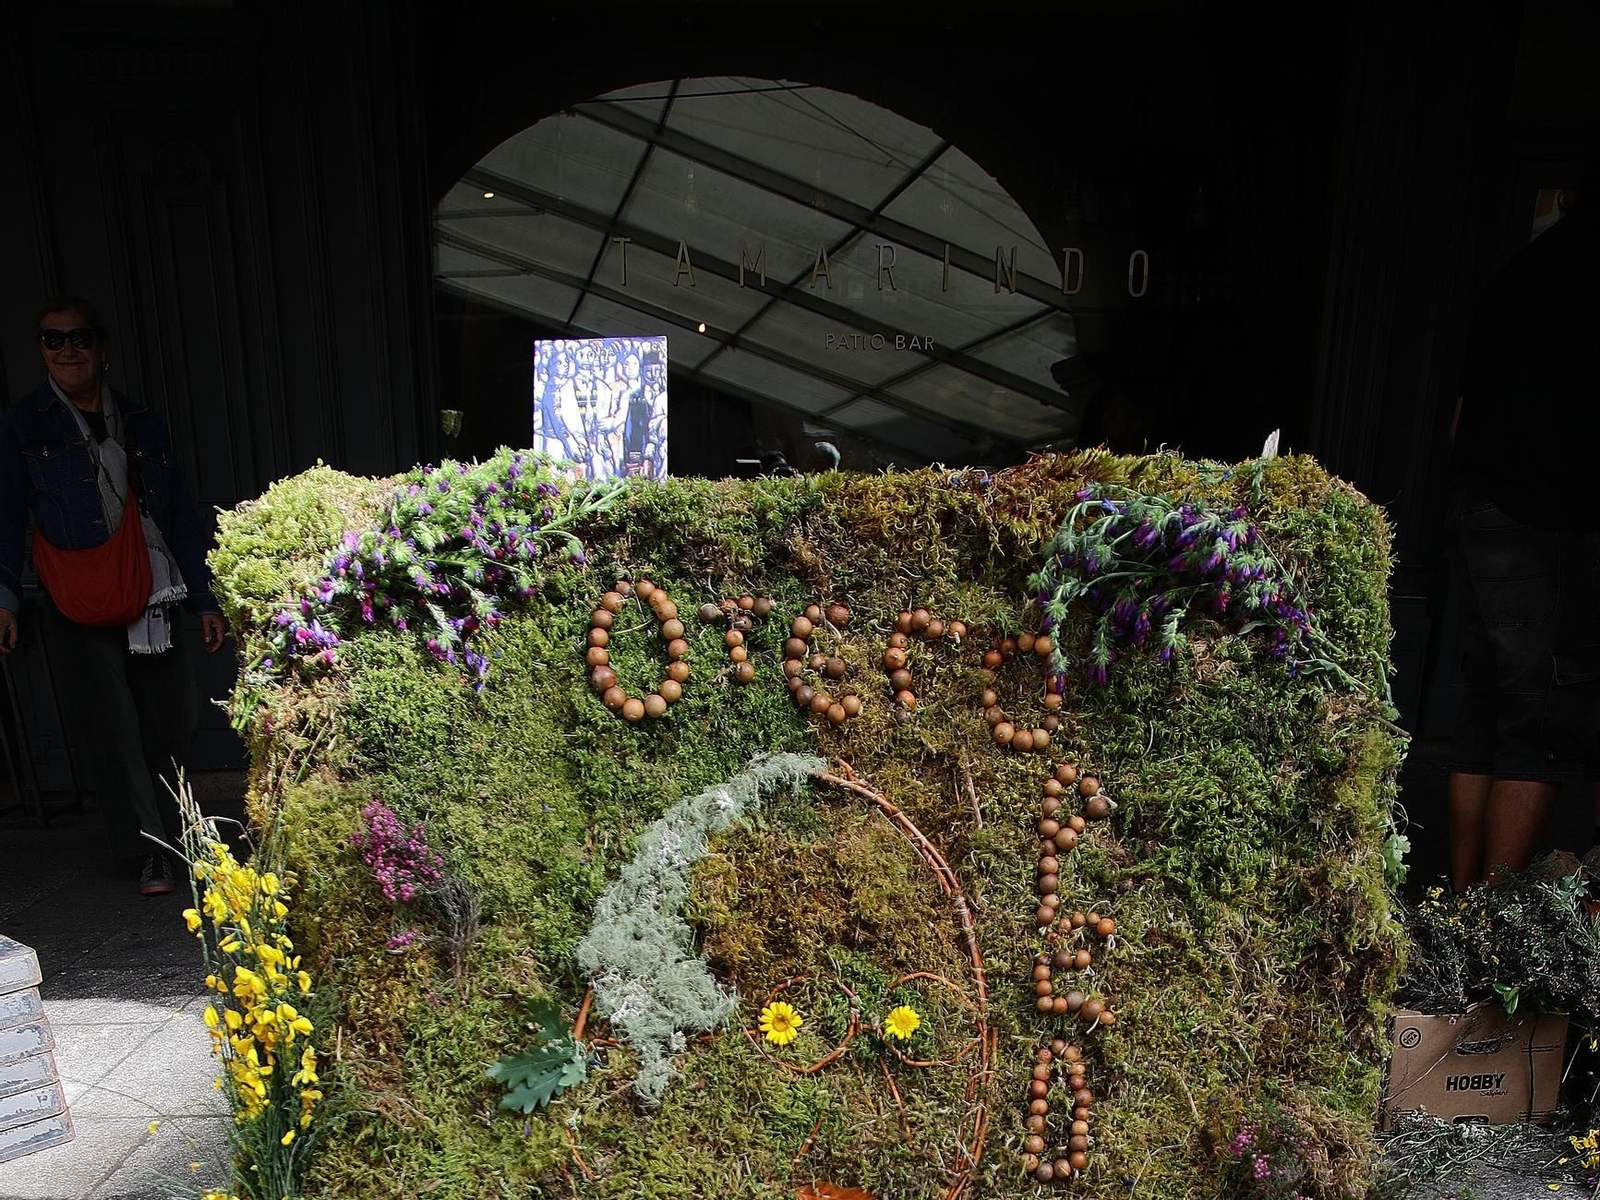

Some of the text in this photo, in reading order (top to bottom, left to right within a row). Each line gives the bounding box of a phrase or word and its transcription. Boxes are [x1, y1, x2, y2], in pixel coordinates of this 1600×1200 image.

[612, 236, 1150, 298] TAMARINDO
[825, 333, 936, 350] PATIO BAR
[1446, 1073, 1506, 1091] HOBBY
